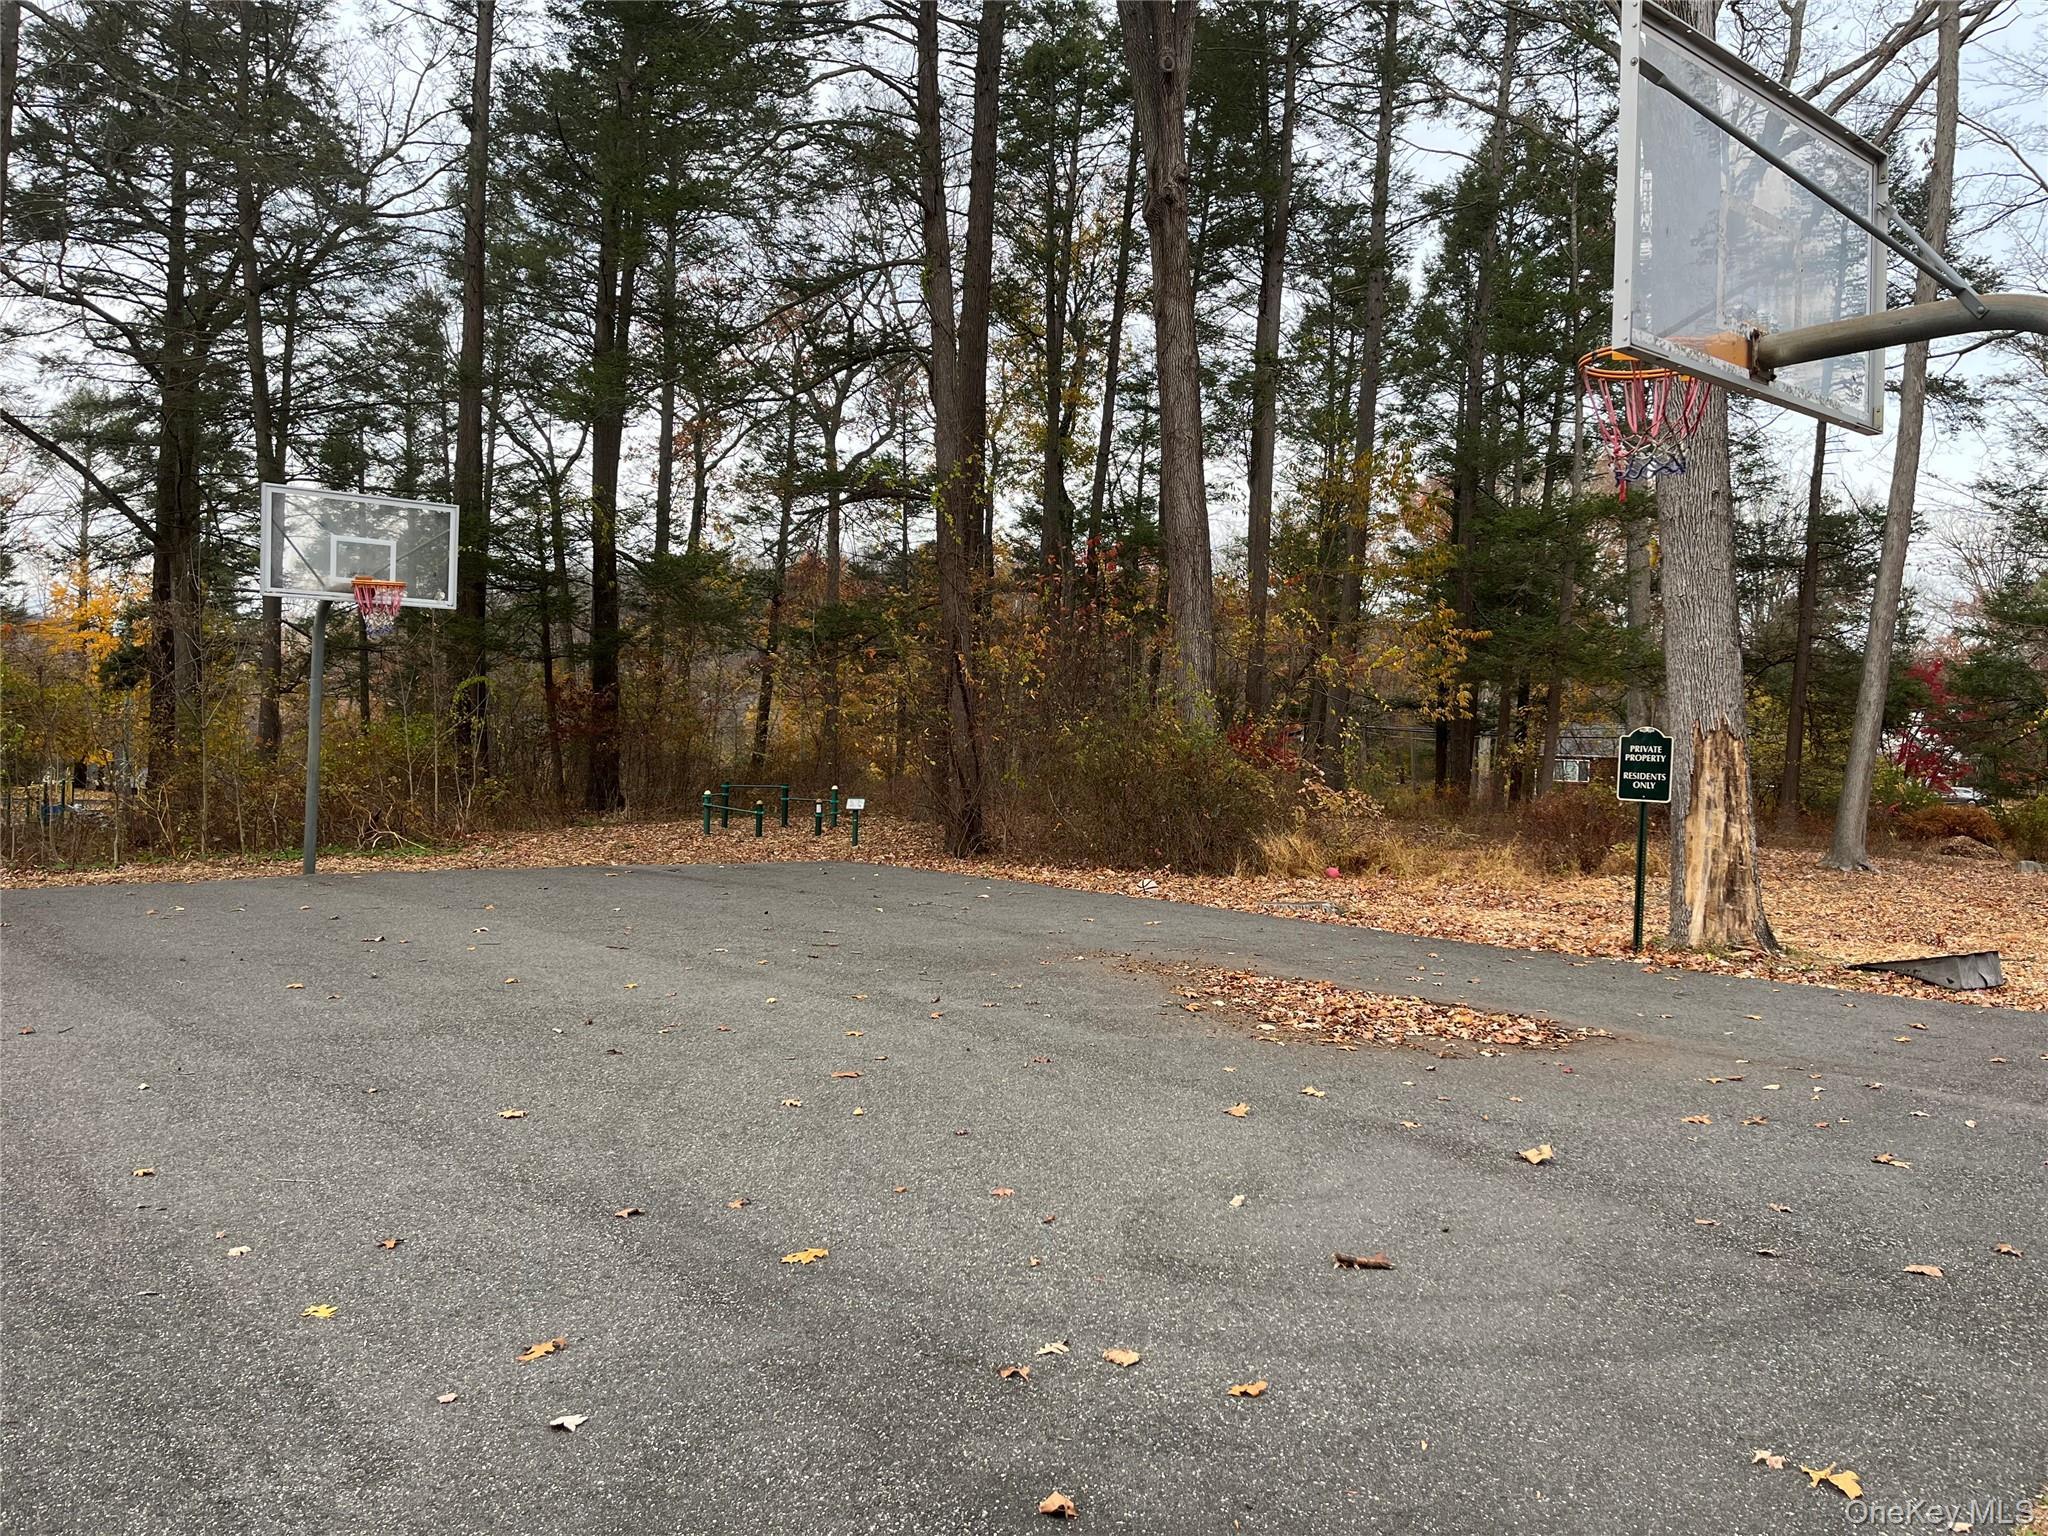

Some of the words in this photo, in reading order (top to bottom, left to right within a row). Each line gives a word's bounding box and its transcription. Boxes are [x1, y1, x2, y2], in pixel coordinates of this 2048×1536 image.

[1630, 745, 1662, 753] PRIVATE
[1625, 754, 1666, 762] PROPERTY
[1623, 772, 1666, 781] RESIDENTS
[1632, 781, 1656, 789] ONLY
